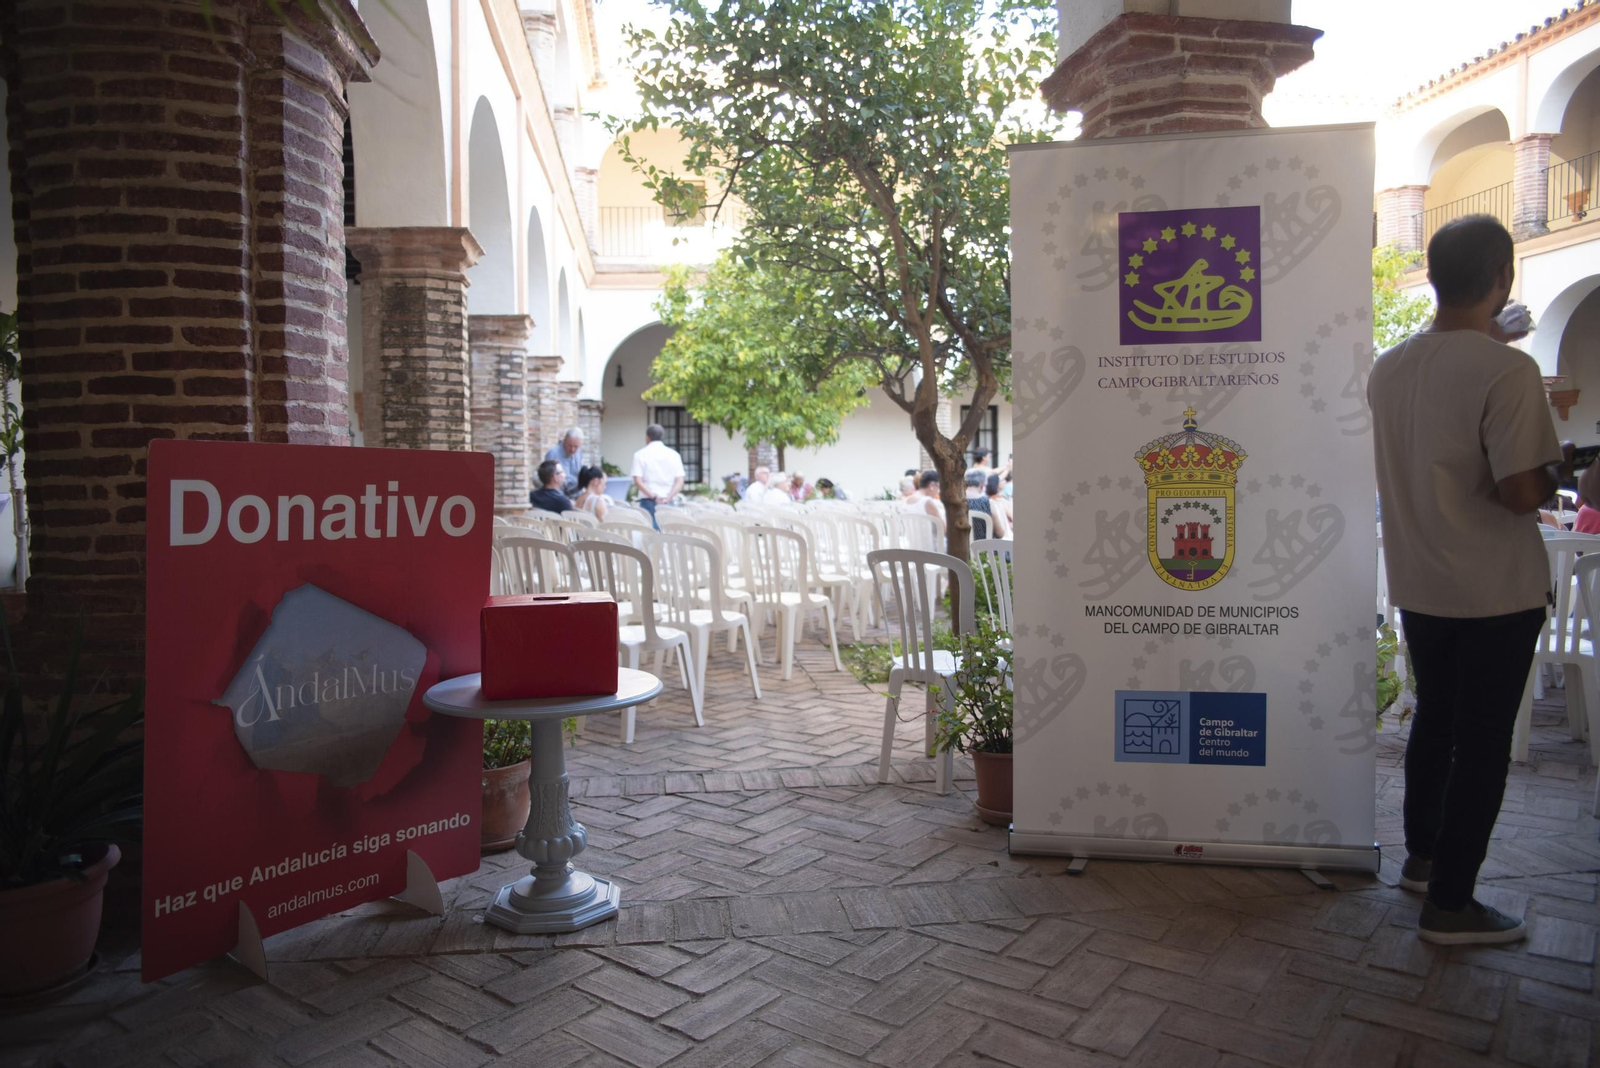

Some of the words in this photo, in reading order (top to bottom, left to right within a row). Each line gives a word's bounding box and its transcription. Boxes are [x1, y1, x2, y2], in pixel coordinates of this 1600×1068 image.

[1098, 354, 1179, 368] INSTITUTO
[1183, 354, 1205, 366] DE
[1209, 351, 1286, 365] ESTUDIOS
[1098, 372, 1280, 389] CAMPOGIBRALTAREÑOS
[1155, 489, 1171, 497] PRO
[169, 479, 477, 547] Donativo
[1226, 505, 1234, 548] HISTORIA
[1085, 605, 1194, 618] MANCOMUNIDAD
[1197, 605, 1216, 618] DE
[1219, 606, 1299, 619] MUNICIPIOS
[1104, 622, 1129, 634] DEL
[1132, 622, 1180, 635] CAMPO
[1183, 622, 1202, 635] DE
[1205, 623, 1279, 635] GIBRALTAR
[1199, 717, 1234, 728] Campo
[1199, 727, 1212, 736] de
[1214, 727, 1258, 737] Gibraltar
[1199, 737, 1231, 746] Centro
[1199, 747, 1214, 756] del
[1216, 748, 1249, 757] mundo
[154, 890, 197, 918] Haz
[203, 876, 244, 903] que
[249, 844, 347, 885] Andalucía
[352, 832, 391, 854] siga
[395, 812, 472, 842] sonando
[267, 872, 380, 919] andalmus.com
